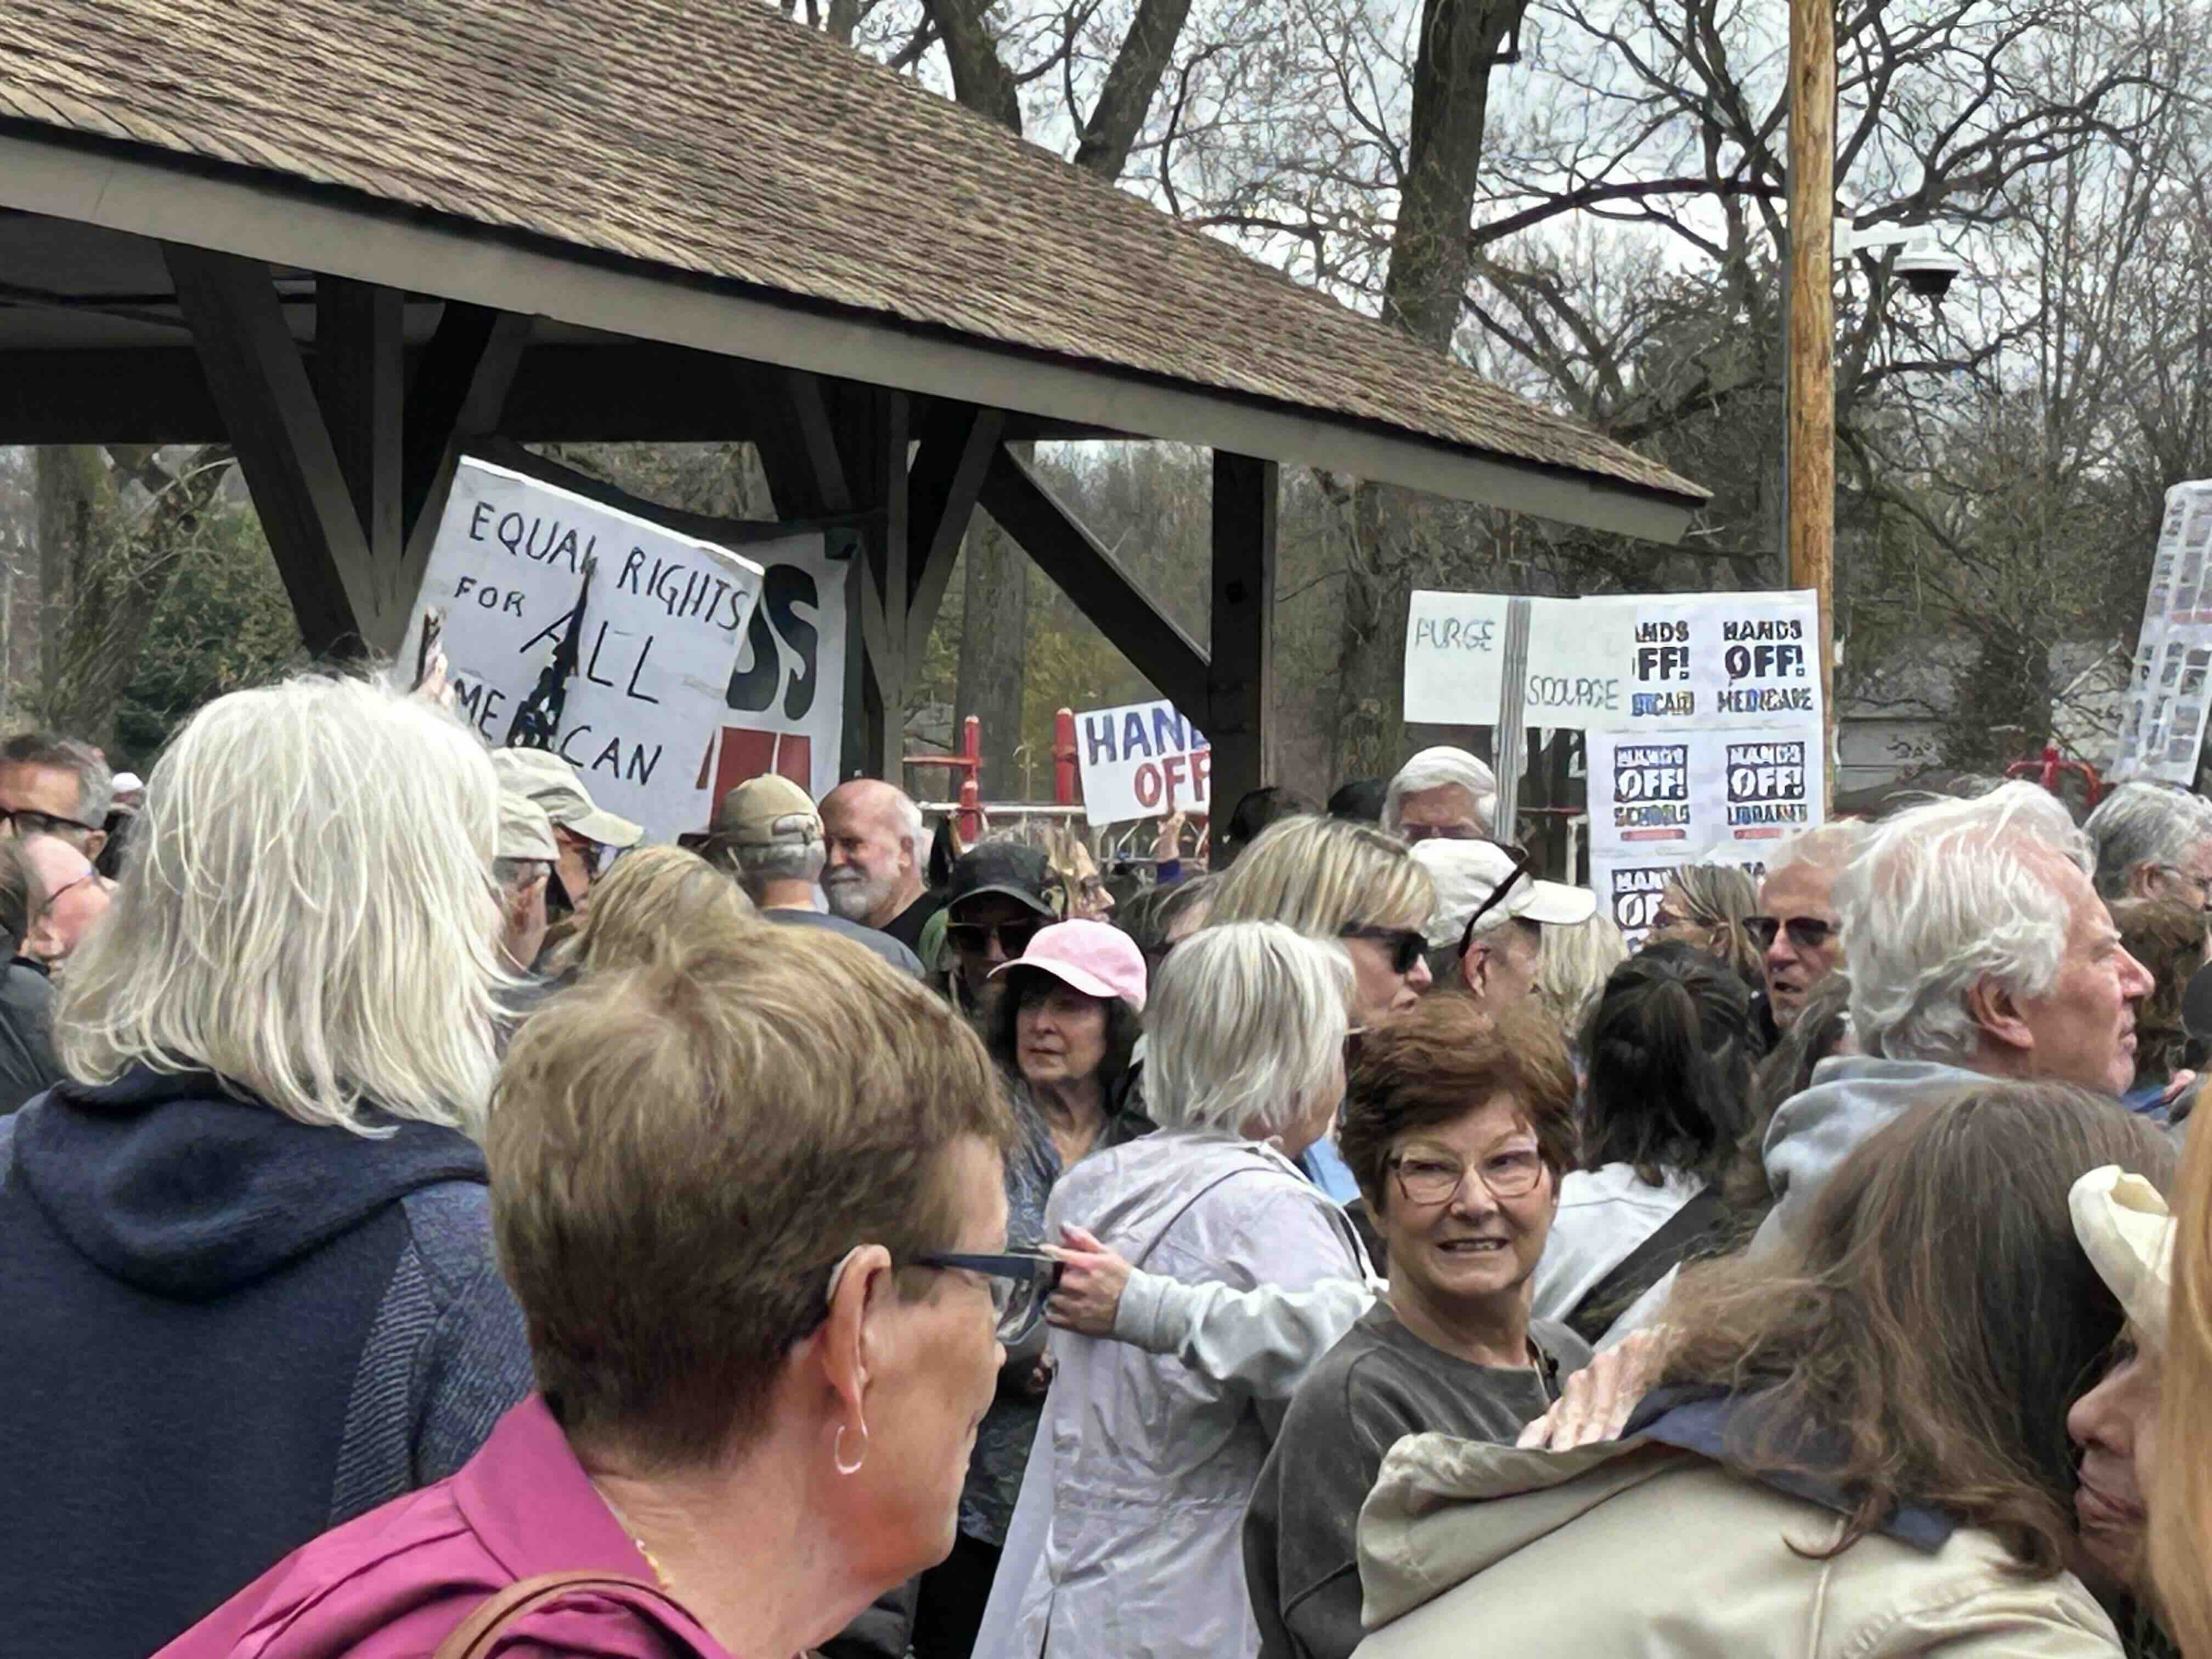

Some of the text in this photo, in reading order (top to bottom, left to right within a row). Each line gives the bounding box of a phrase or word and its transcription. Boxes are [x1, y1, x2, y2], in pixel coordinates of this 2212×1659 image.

[469, 501, 749, 630] EQUAL RIGHTS
[454, 575, 526, 617] FOR
[1415, 617, 1496, 652] PURGE
[1723, 619, 1803, 641] HANDS
[520, 609, 659, 704] ALL
[1632, 646, 1690, 681] FF!
[1724, 645, 1805, 680] OFF!
[1618, 768, 1685, 798] OFF!
[1731, 766, 1803, 797] OFF!
